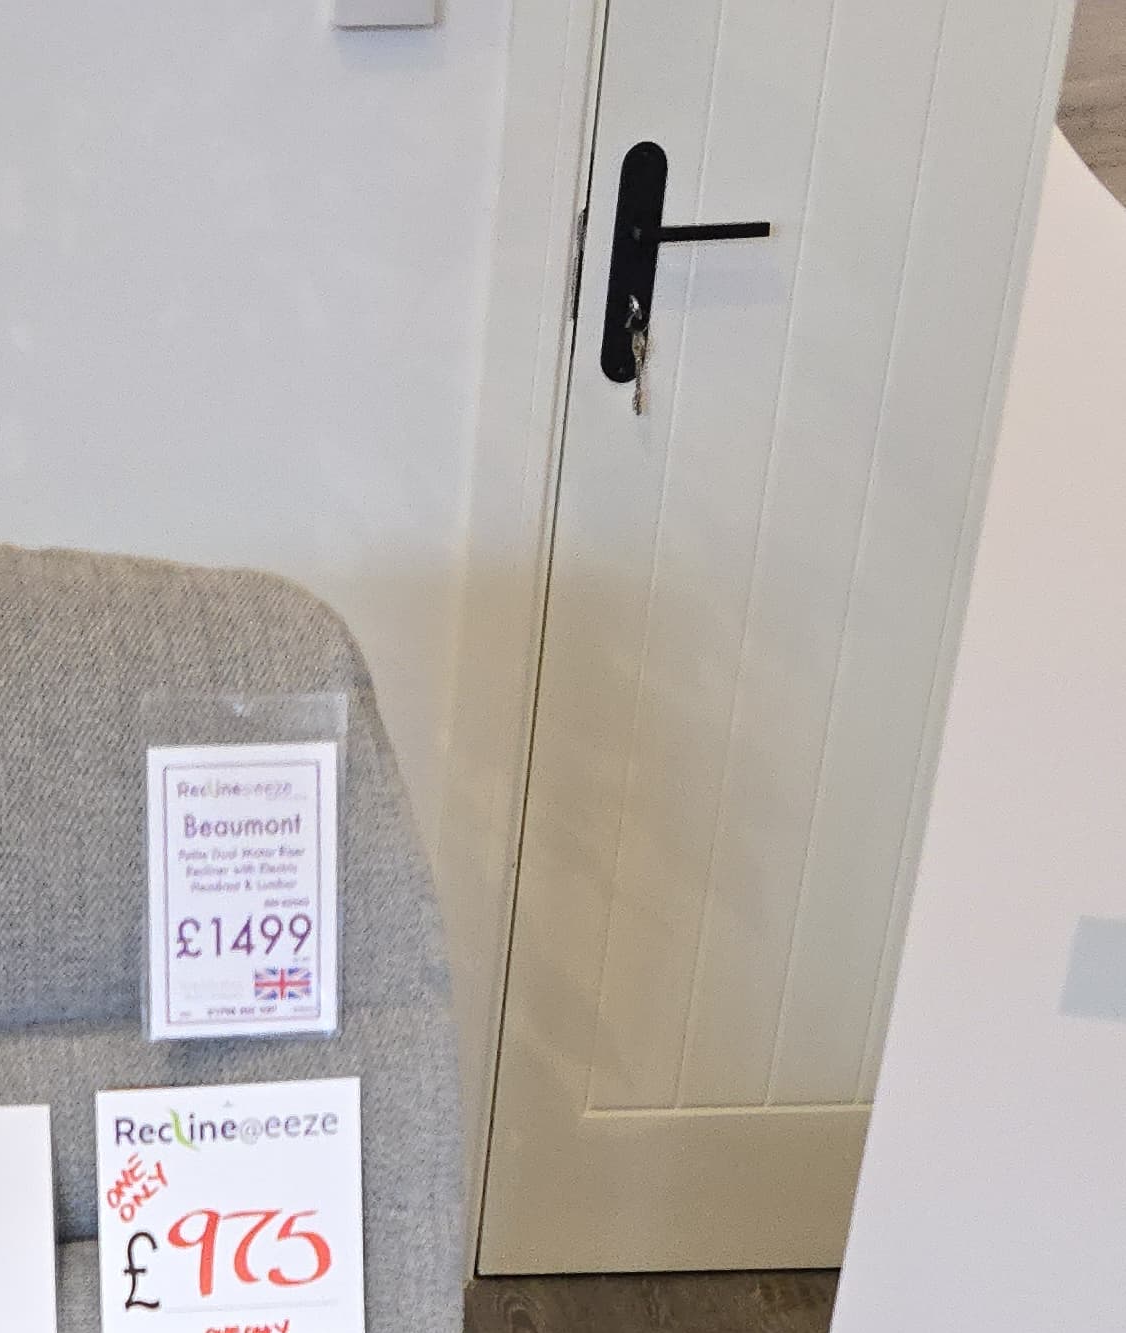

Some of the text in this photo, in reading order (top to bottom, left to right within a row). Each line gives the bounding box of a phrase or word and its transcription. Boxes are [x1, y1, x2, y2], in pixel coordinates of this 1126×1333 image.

[184, 813, 302, 838] Beaumont
[176, 913, 312, 959] £1499
[107, 1153, 146, 1209] ONE
[119, 1161, 169, 1223] ONLY
